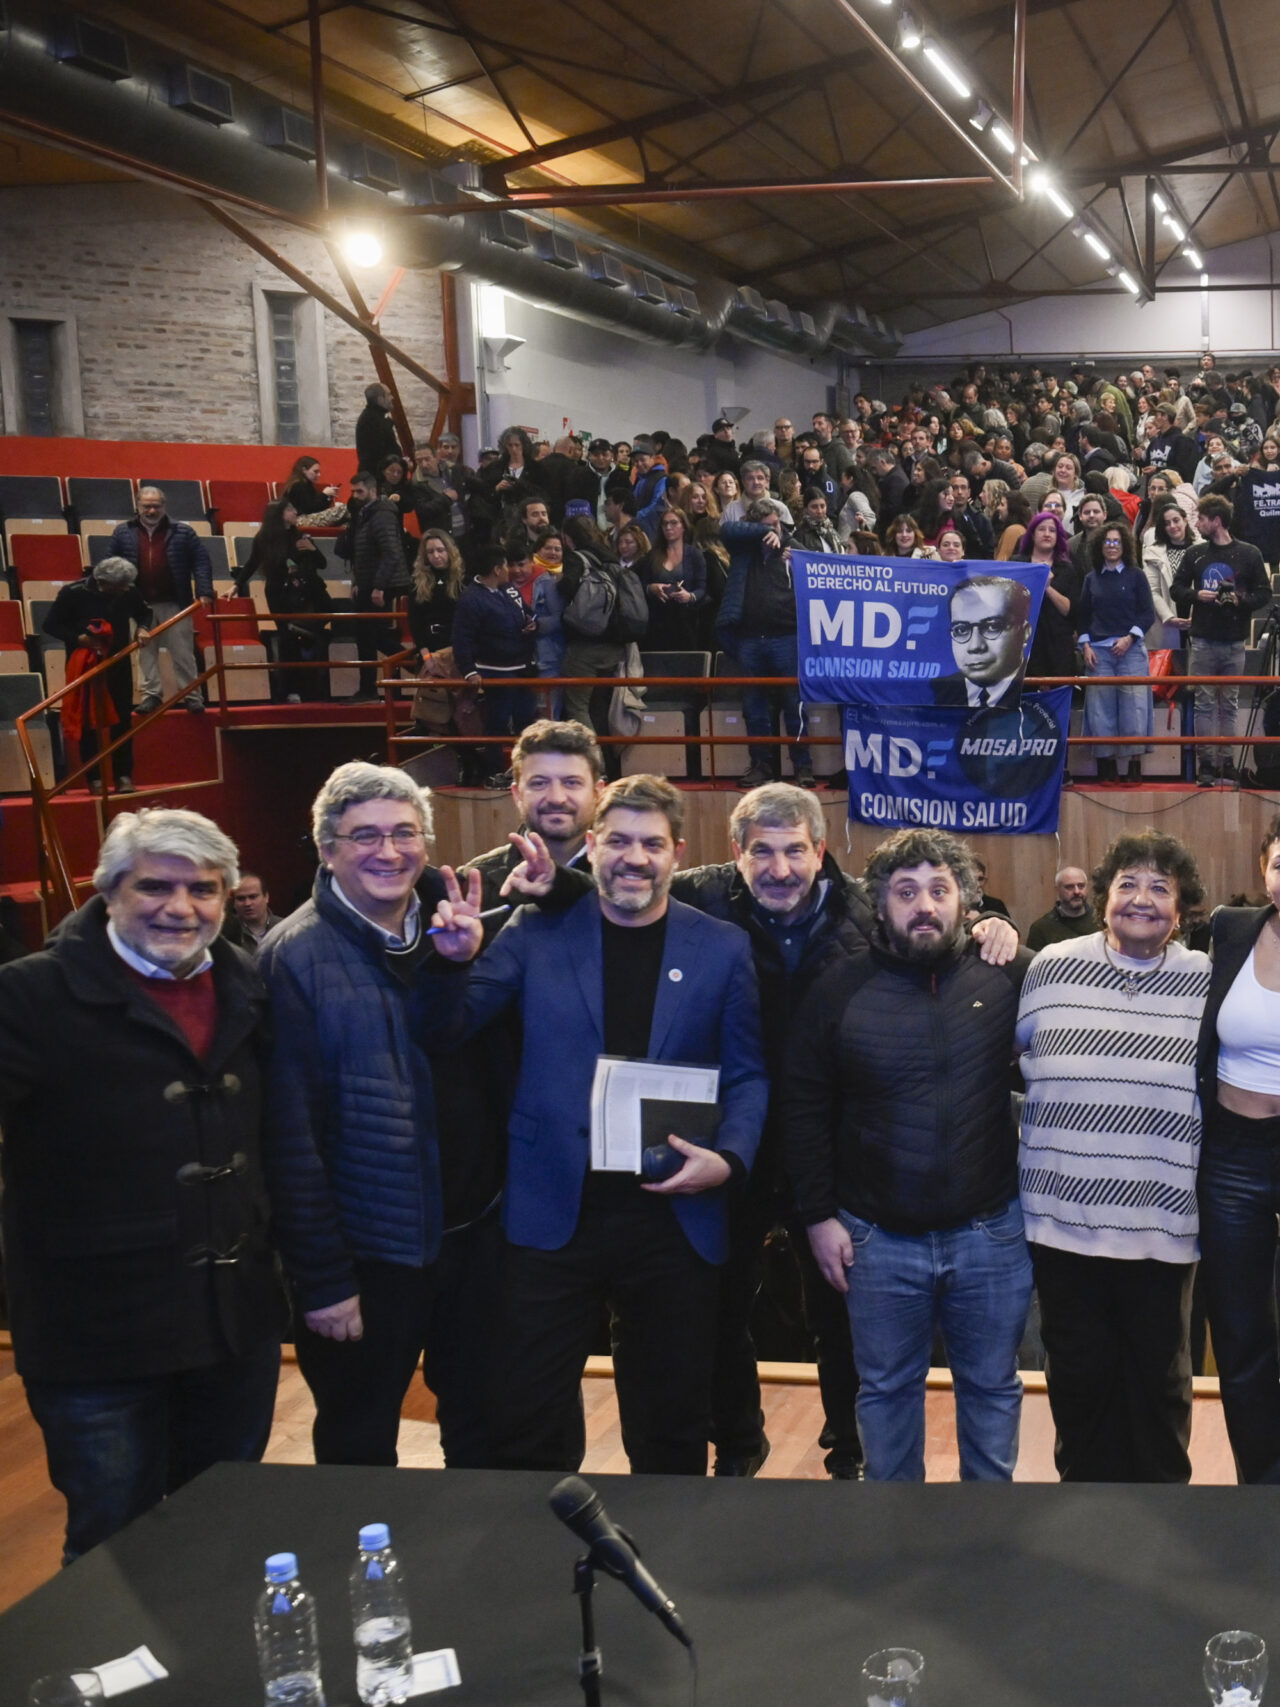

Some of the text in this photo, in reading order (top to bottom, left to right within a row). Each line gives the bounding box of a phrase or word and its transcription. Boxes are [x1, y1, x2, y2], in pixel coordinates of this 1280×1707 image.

[806, 563, 893, 579] MOVIMIENTO
[807, 577, 948, 596] DERECHO AL FUTURO
[805, 656, 942, 679] COMISION SALUD
[959, 738, 1058, 757] MOSAPRO
[860, 792, 1027, 828] COMISION SALUD
